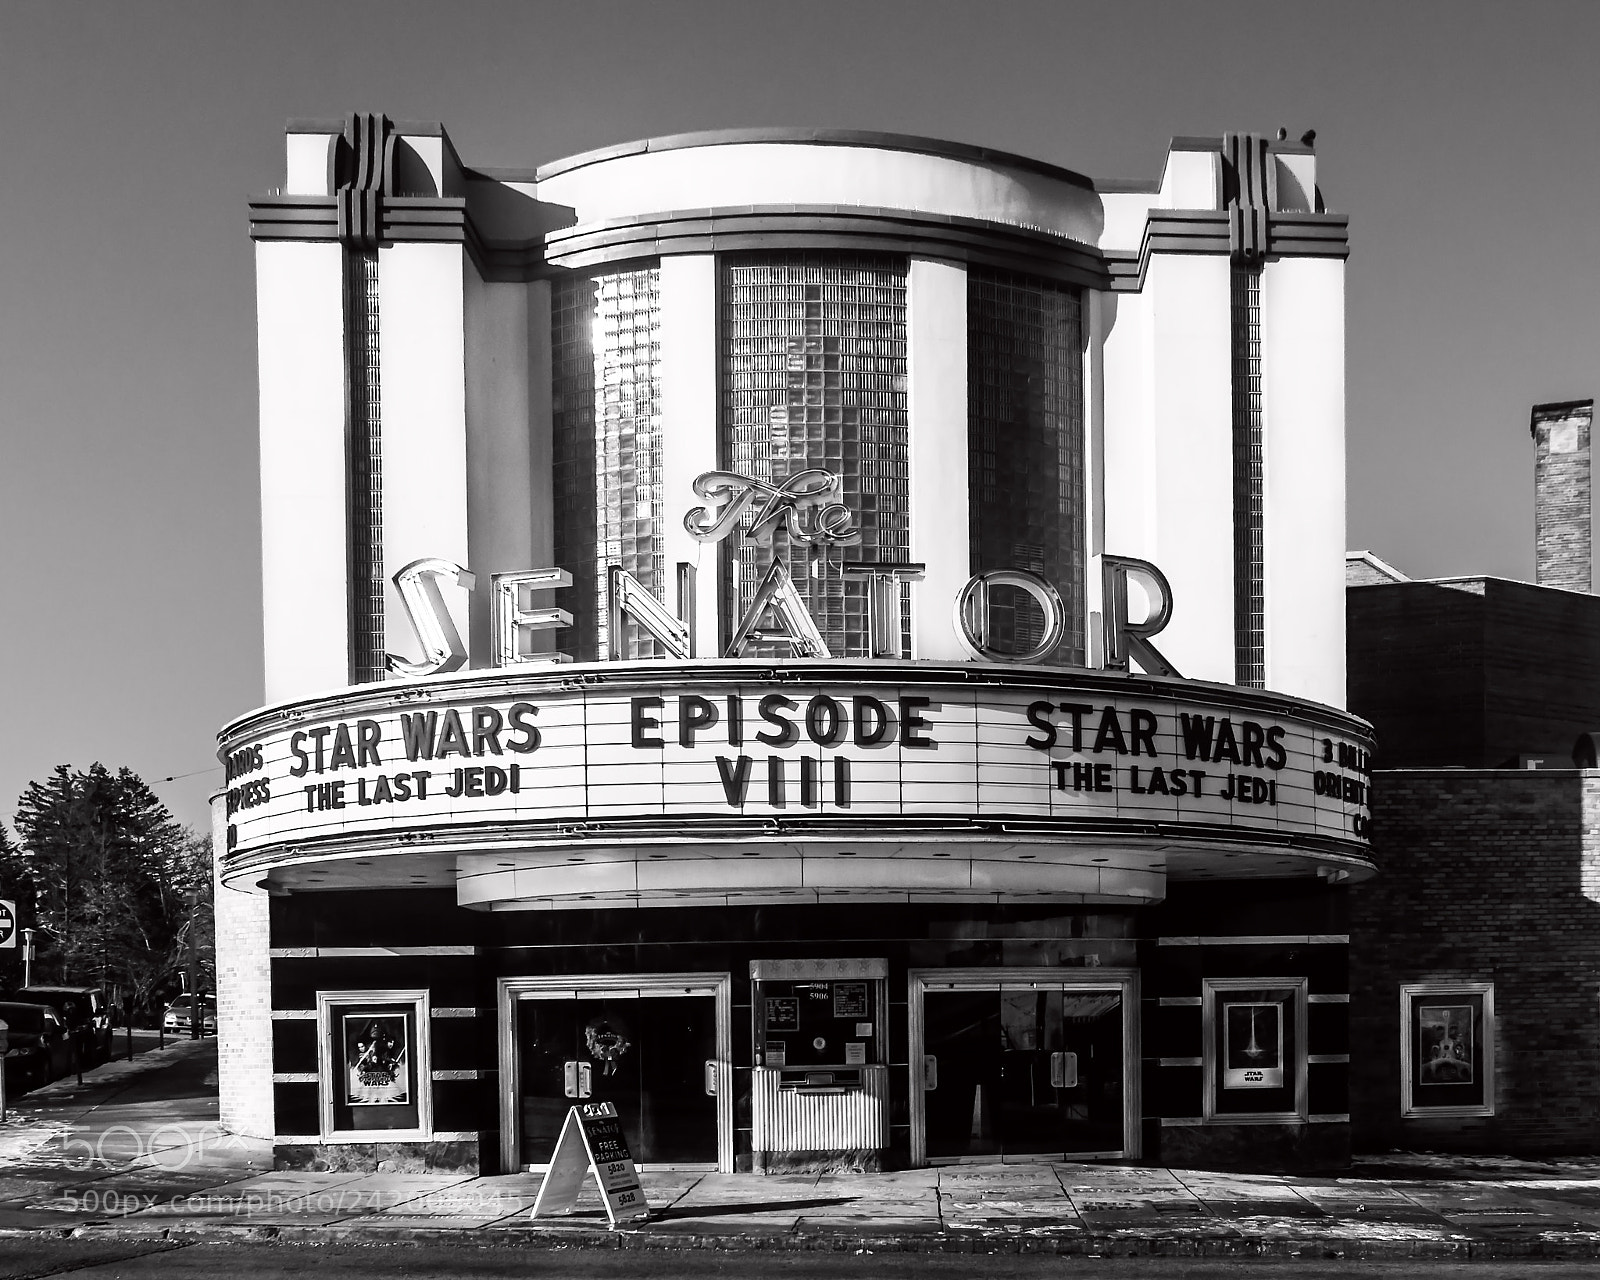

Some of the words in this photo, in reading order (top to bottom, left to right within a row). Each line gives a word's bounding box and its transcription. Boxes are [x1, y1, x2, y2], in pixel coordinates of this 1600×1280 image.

[684, 468, 862, 546] The
[385, 553, 1184, 678] SENATOR
[290, 719, 381, 778] STAR
[400, 703, 541, 762] WARS
[631, 694, 936, 749] EPISODE
[1026, 700, 1157, 757] STAR
[1181, 712, 1287, 770] WARS
[1323, 738, 1334, 763] 3
[304, 780, 346, 813] THE
[358, 771, 432, 806] LAST
[445, 764, 520, 798] JEDI
[715, 756, 850, 809] VIII
[1051, 761, 1112, 792] THE
[1131, 765, 1206, 798] LAST
[1221, 774, 1276, 806] JEDI
[809, 983, 829, 991] 5904
[809, 992, 829, 1000] 5906
[594, 1149, 629, 1161] PARKING
[599, 1140, 619, 1150] FREE
[607, 1163, 625, 1175] 5820
